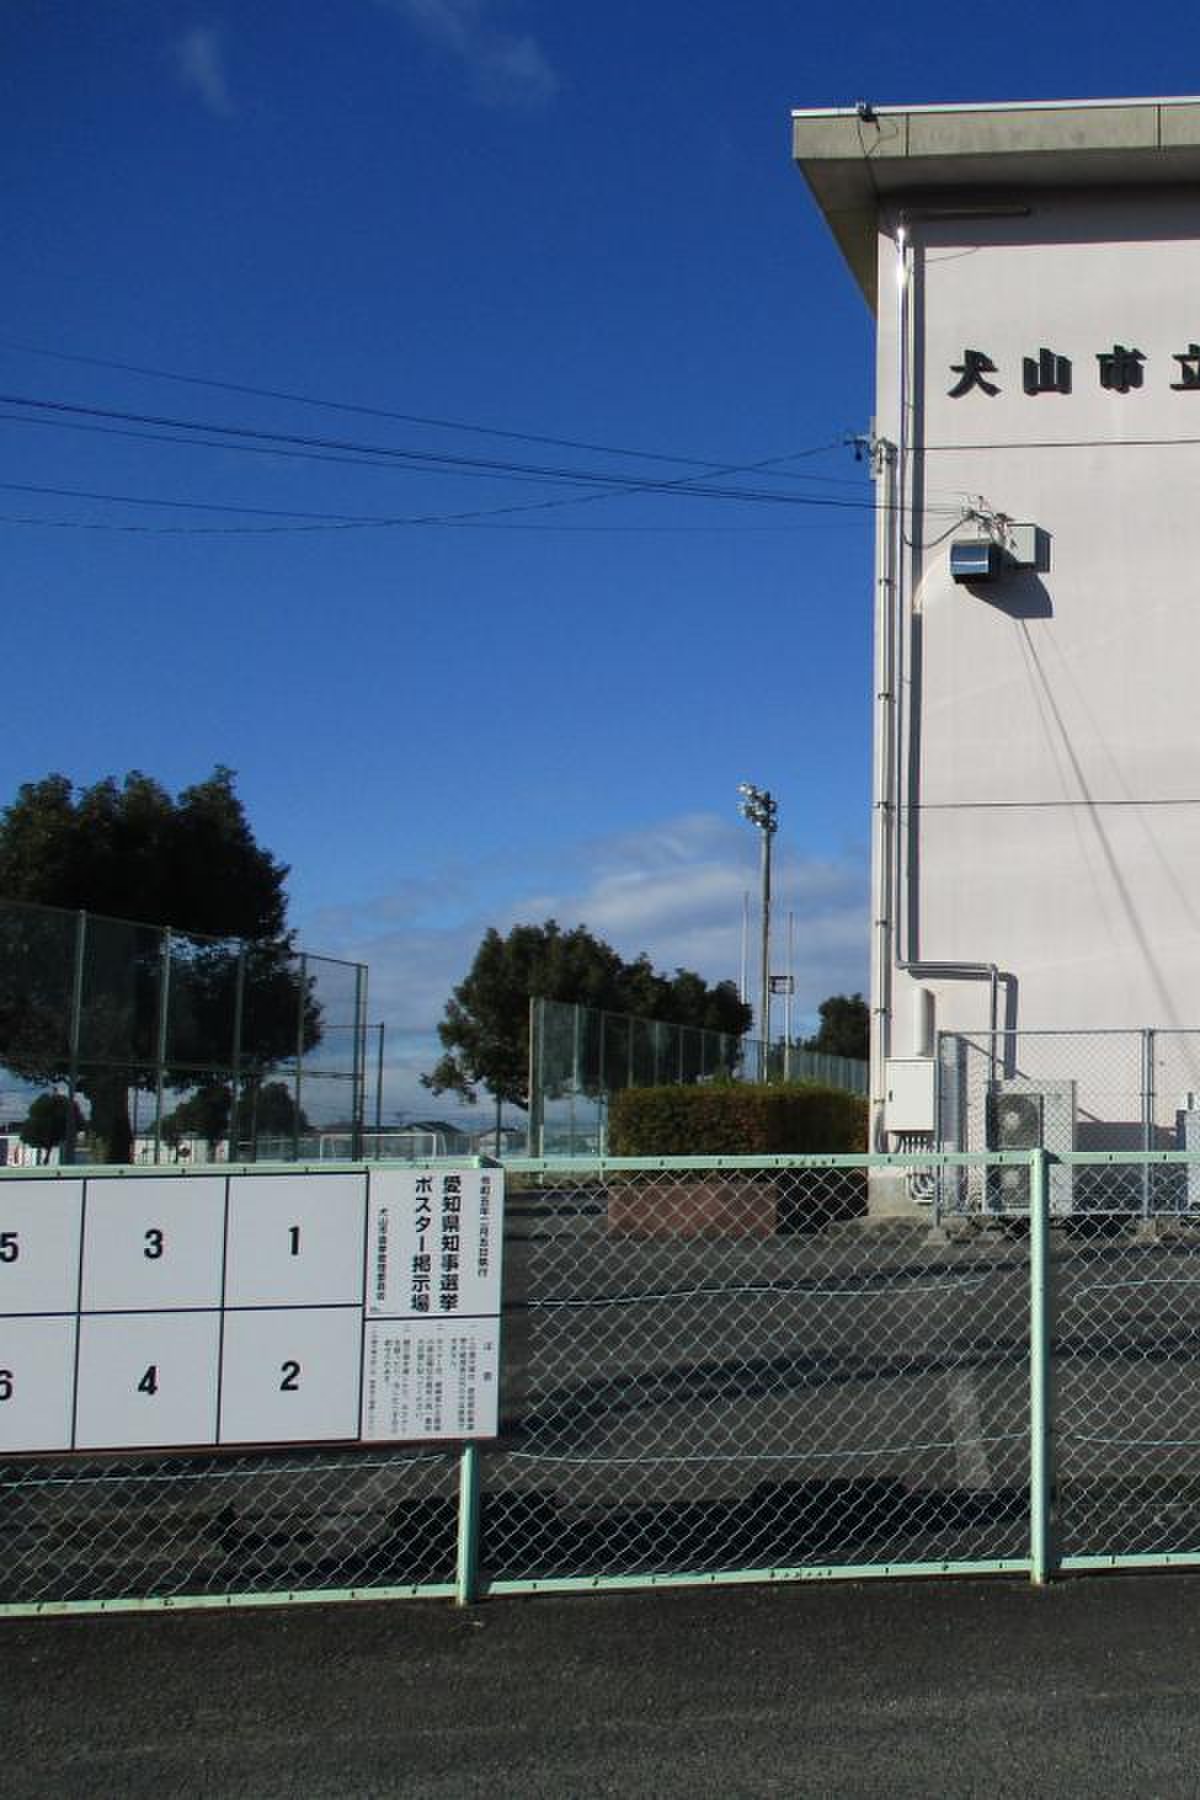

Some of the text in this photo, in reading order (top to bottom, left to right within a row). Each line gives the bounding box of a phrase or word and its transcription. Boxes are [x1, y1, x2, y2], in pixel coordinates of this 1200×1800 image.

[0, 1231, 18, 1263] 5
[144, 1229, 163, 1259] 3
[289, 1226, 300, 1256] 1
[411, 1174, 432, 1312] ポスター掲示場
[439, 1174, 461, 1312] 愛知県知事選挙
[138, 1366, 158, 1396] 4
[280, 1361, 301, 1391] 2
